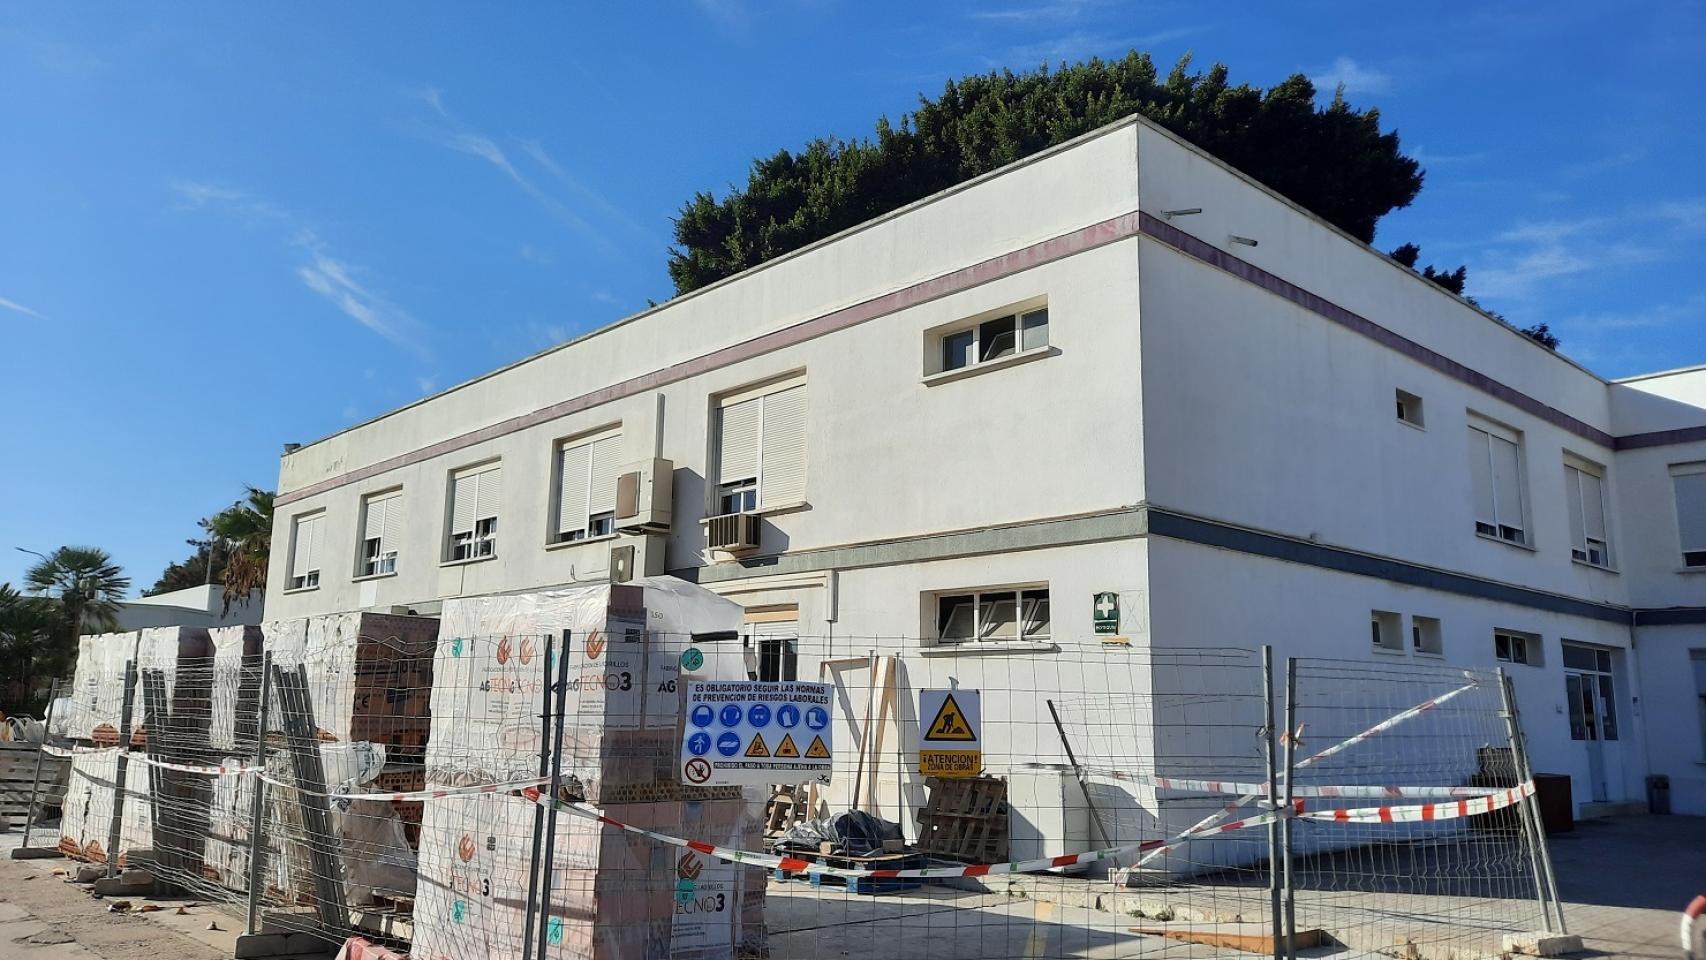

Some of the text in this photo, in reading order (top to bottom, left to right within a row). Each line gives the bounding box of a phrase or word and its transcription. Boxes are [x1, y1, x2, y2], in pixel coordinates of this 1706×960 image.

[695, 684, 825, 695] ES OBLIGATORIO SEGUIR LAS NORMAS
[692, 693, 829, 705] DE PREVENCION DE RIESGOS LABORALES
